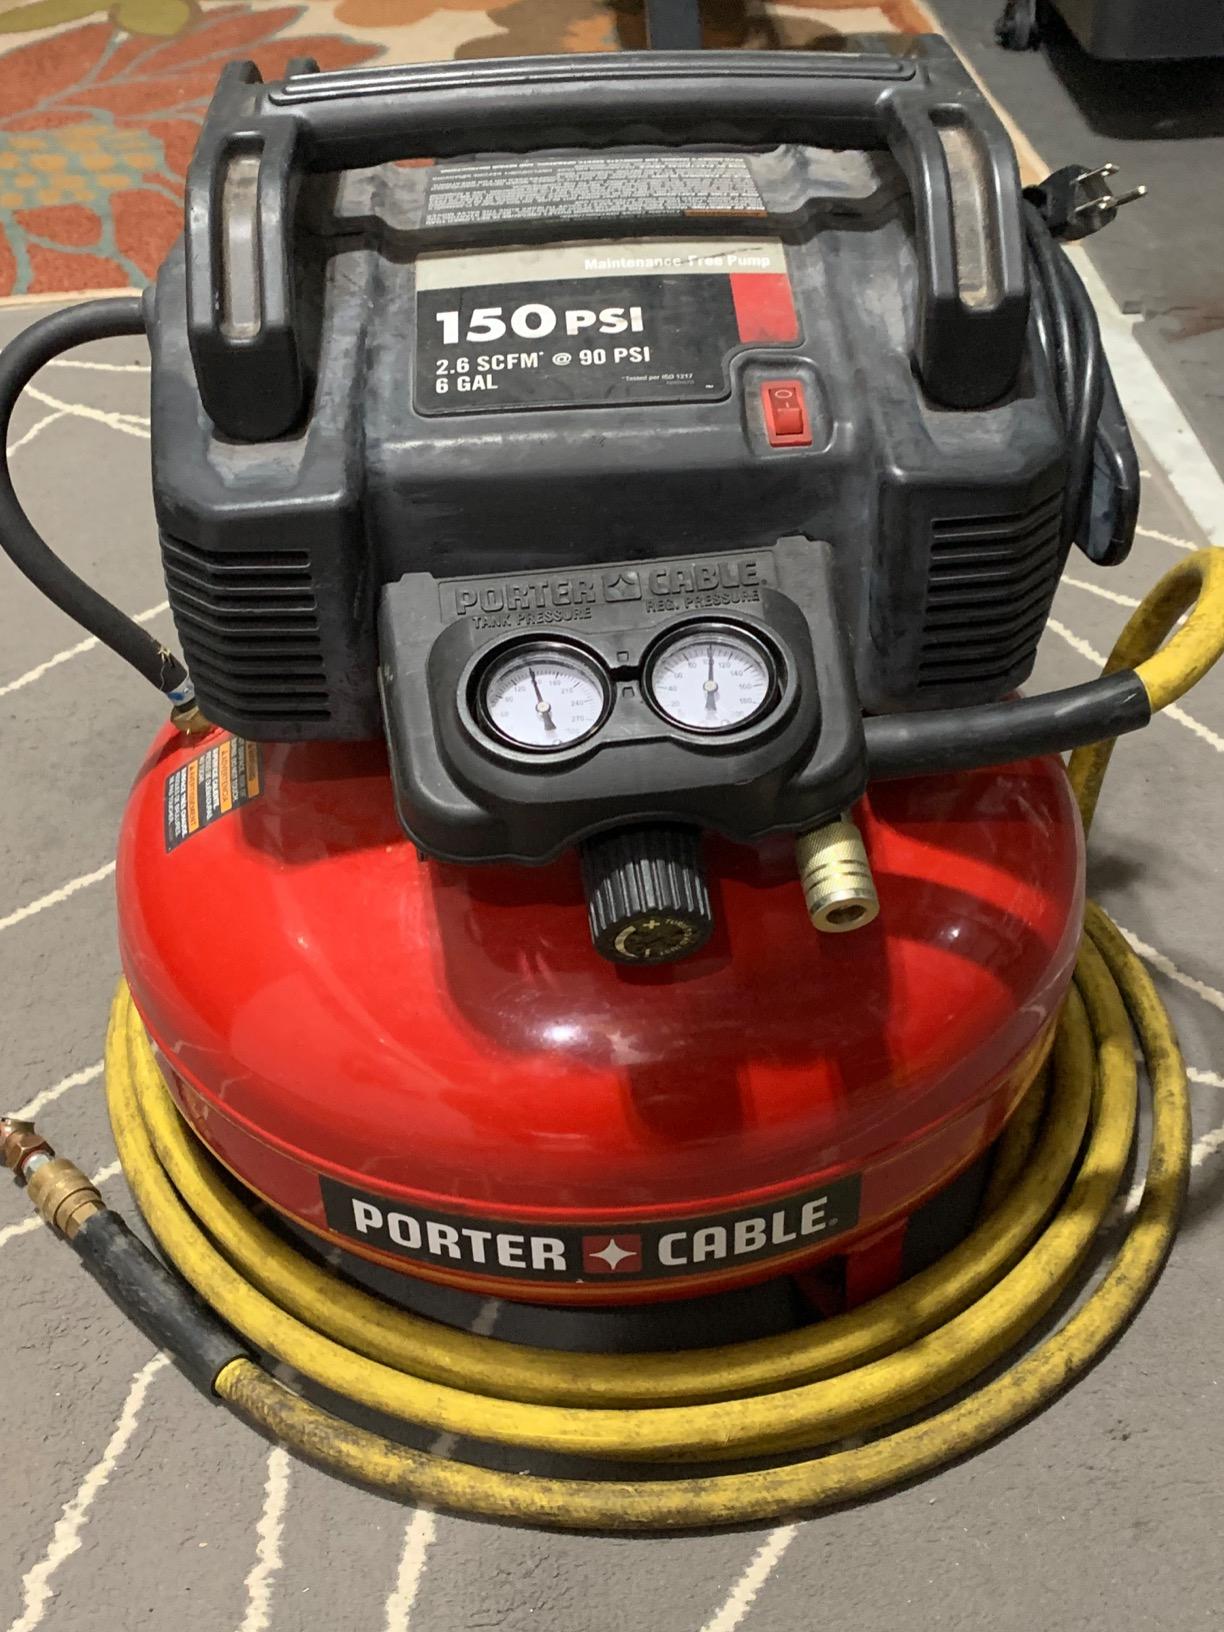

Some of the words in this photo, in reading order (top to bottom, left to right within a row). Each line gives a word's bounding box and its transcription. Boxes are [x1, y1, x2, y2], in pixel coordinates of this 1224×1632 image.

[584, 256, 681, 270] Maintenance
[688, 254, 722, 267] Free
[728, 254, 770, 268] Pump
[436, 304, 556, 344] 150
[566, 306, 644, 336] PSI
[436, 358, 470, 375] 2.6
[552, 352, 572, 366] @
[580, 350, 606, 366] 90
[614, 346, 650, 363] PSI
[436, 376, 448, 394] 6
[458, 374, 498, 392] GAL
[456, 580, 596, 615] PORTER
[648, 563, 760, 596] CABLE
[646, 599, 680, 613] REG.
[685, 590, 760, 609] PRESSURE
[472, 615, 512, 630] TANK
[517, 608, 592, 626] PRESSURE
[352, 1198, 567, 1272] PORTER
[658, 1196, 828, 1266] CABLE
